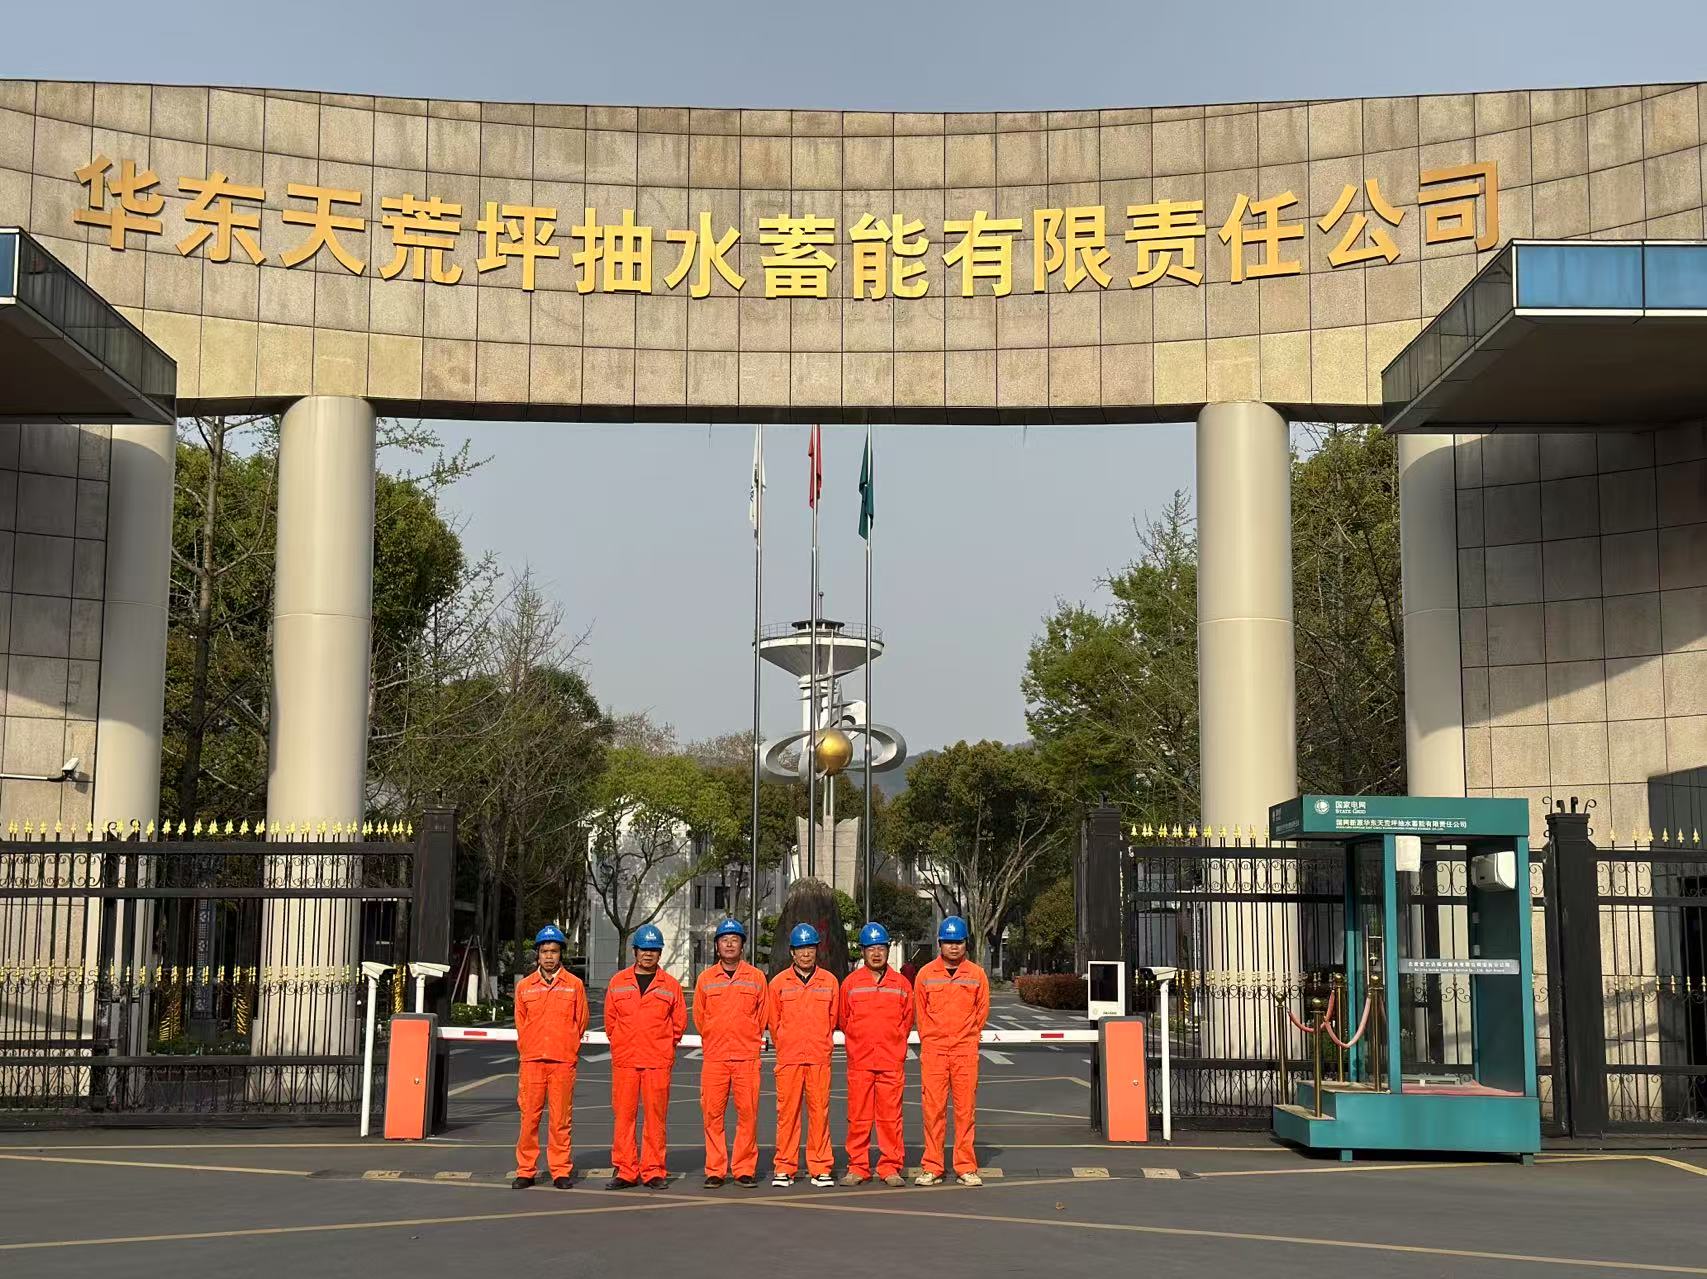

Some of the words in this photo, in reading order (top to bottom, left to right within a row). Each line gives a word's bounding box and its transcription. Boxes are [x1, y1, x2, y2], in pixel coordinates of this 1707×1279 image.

[74, 154, 1499, 300] 华东天荒坪抽水蓄能有限责任公司
[1335, 800, 1366, 809] 国家电网
